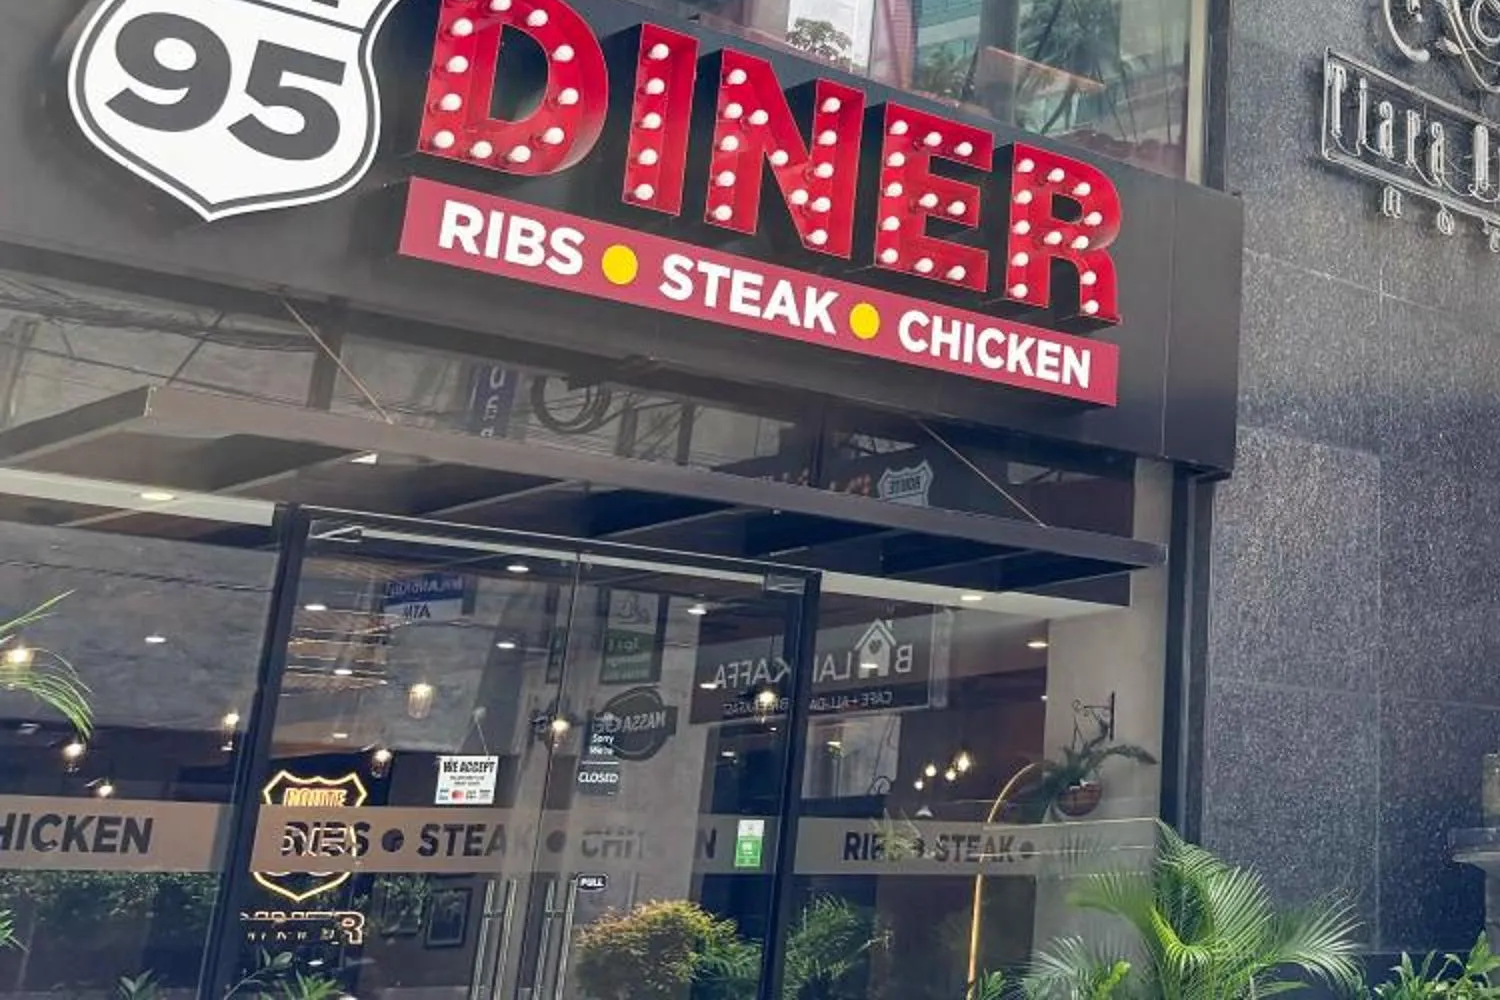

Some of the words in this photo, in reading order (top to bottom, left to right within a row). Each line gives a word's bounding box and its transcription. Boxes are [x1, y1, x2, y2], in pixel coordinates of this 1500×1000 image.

[104, 11, 346, 161] 95
[438, 199, 585, 275] RIBS
[659, 254, 839, 334] STEAK
[898, 310, 1091, 389] CHICKEN
[460, 761, 496, 773] ACCEPT
[578, 771, 619, 783] CLOSED
[934, 833, 1016, 863] STEAK
[580, 877, 605, 887] PULL
